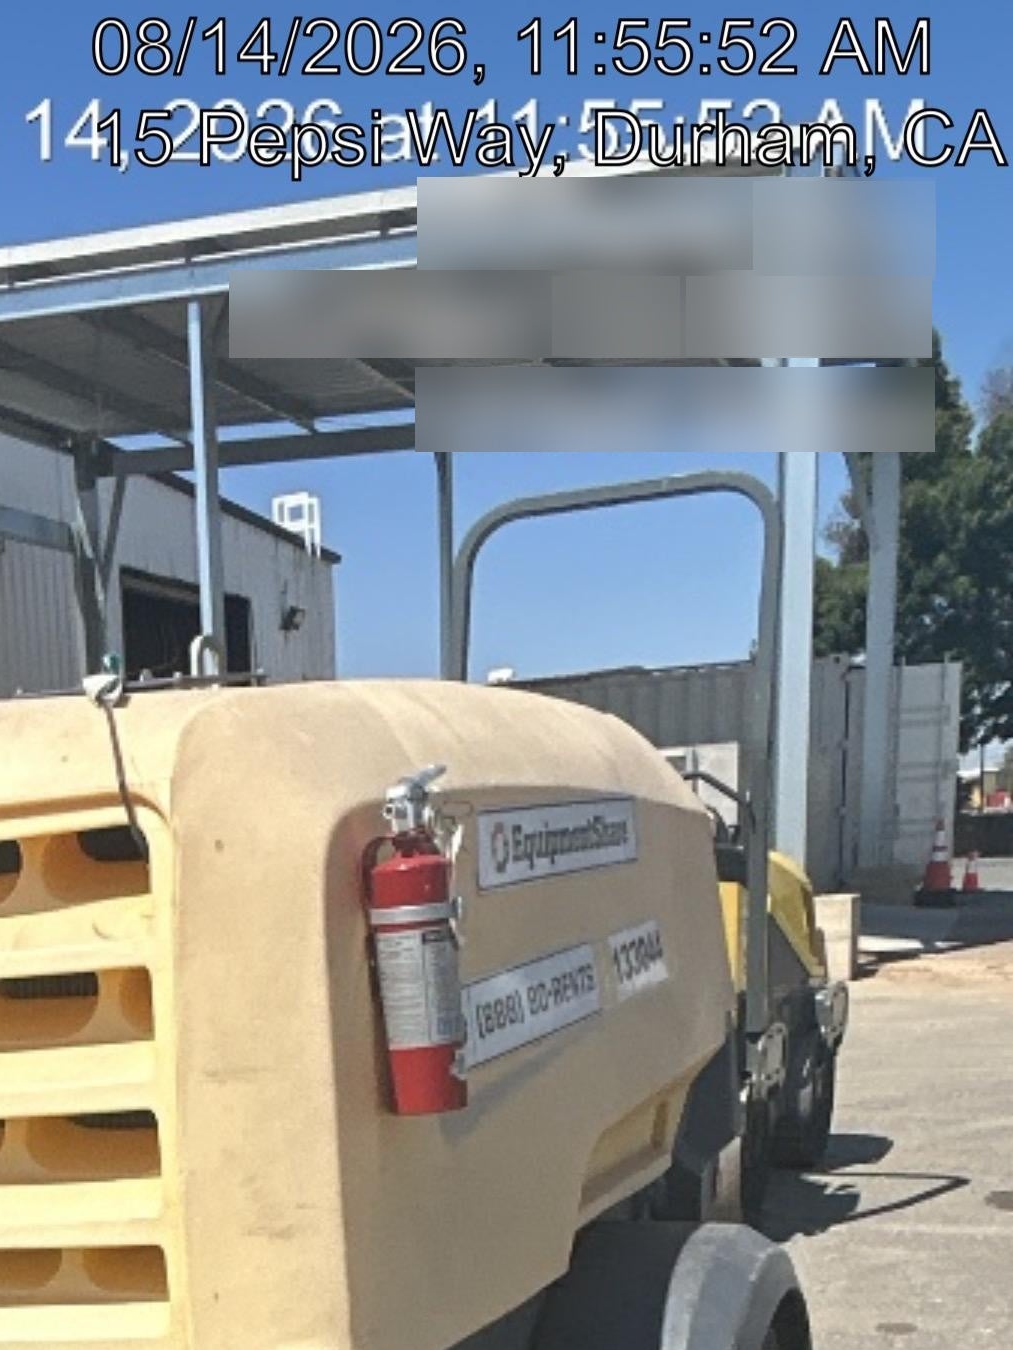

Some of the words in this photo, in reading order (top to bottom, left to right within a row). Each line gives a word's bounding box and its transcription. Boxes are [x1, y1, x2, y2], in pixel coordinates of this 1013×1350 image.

[511, 814, 629, 871] EquipmentShare
[475, 987, 525, 1040] (888)
[527, 962, 595, 1016] 80-RENTS
